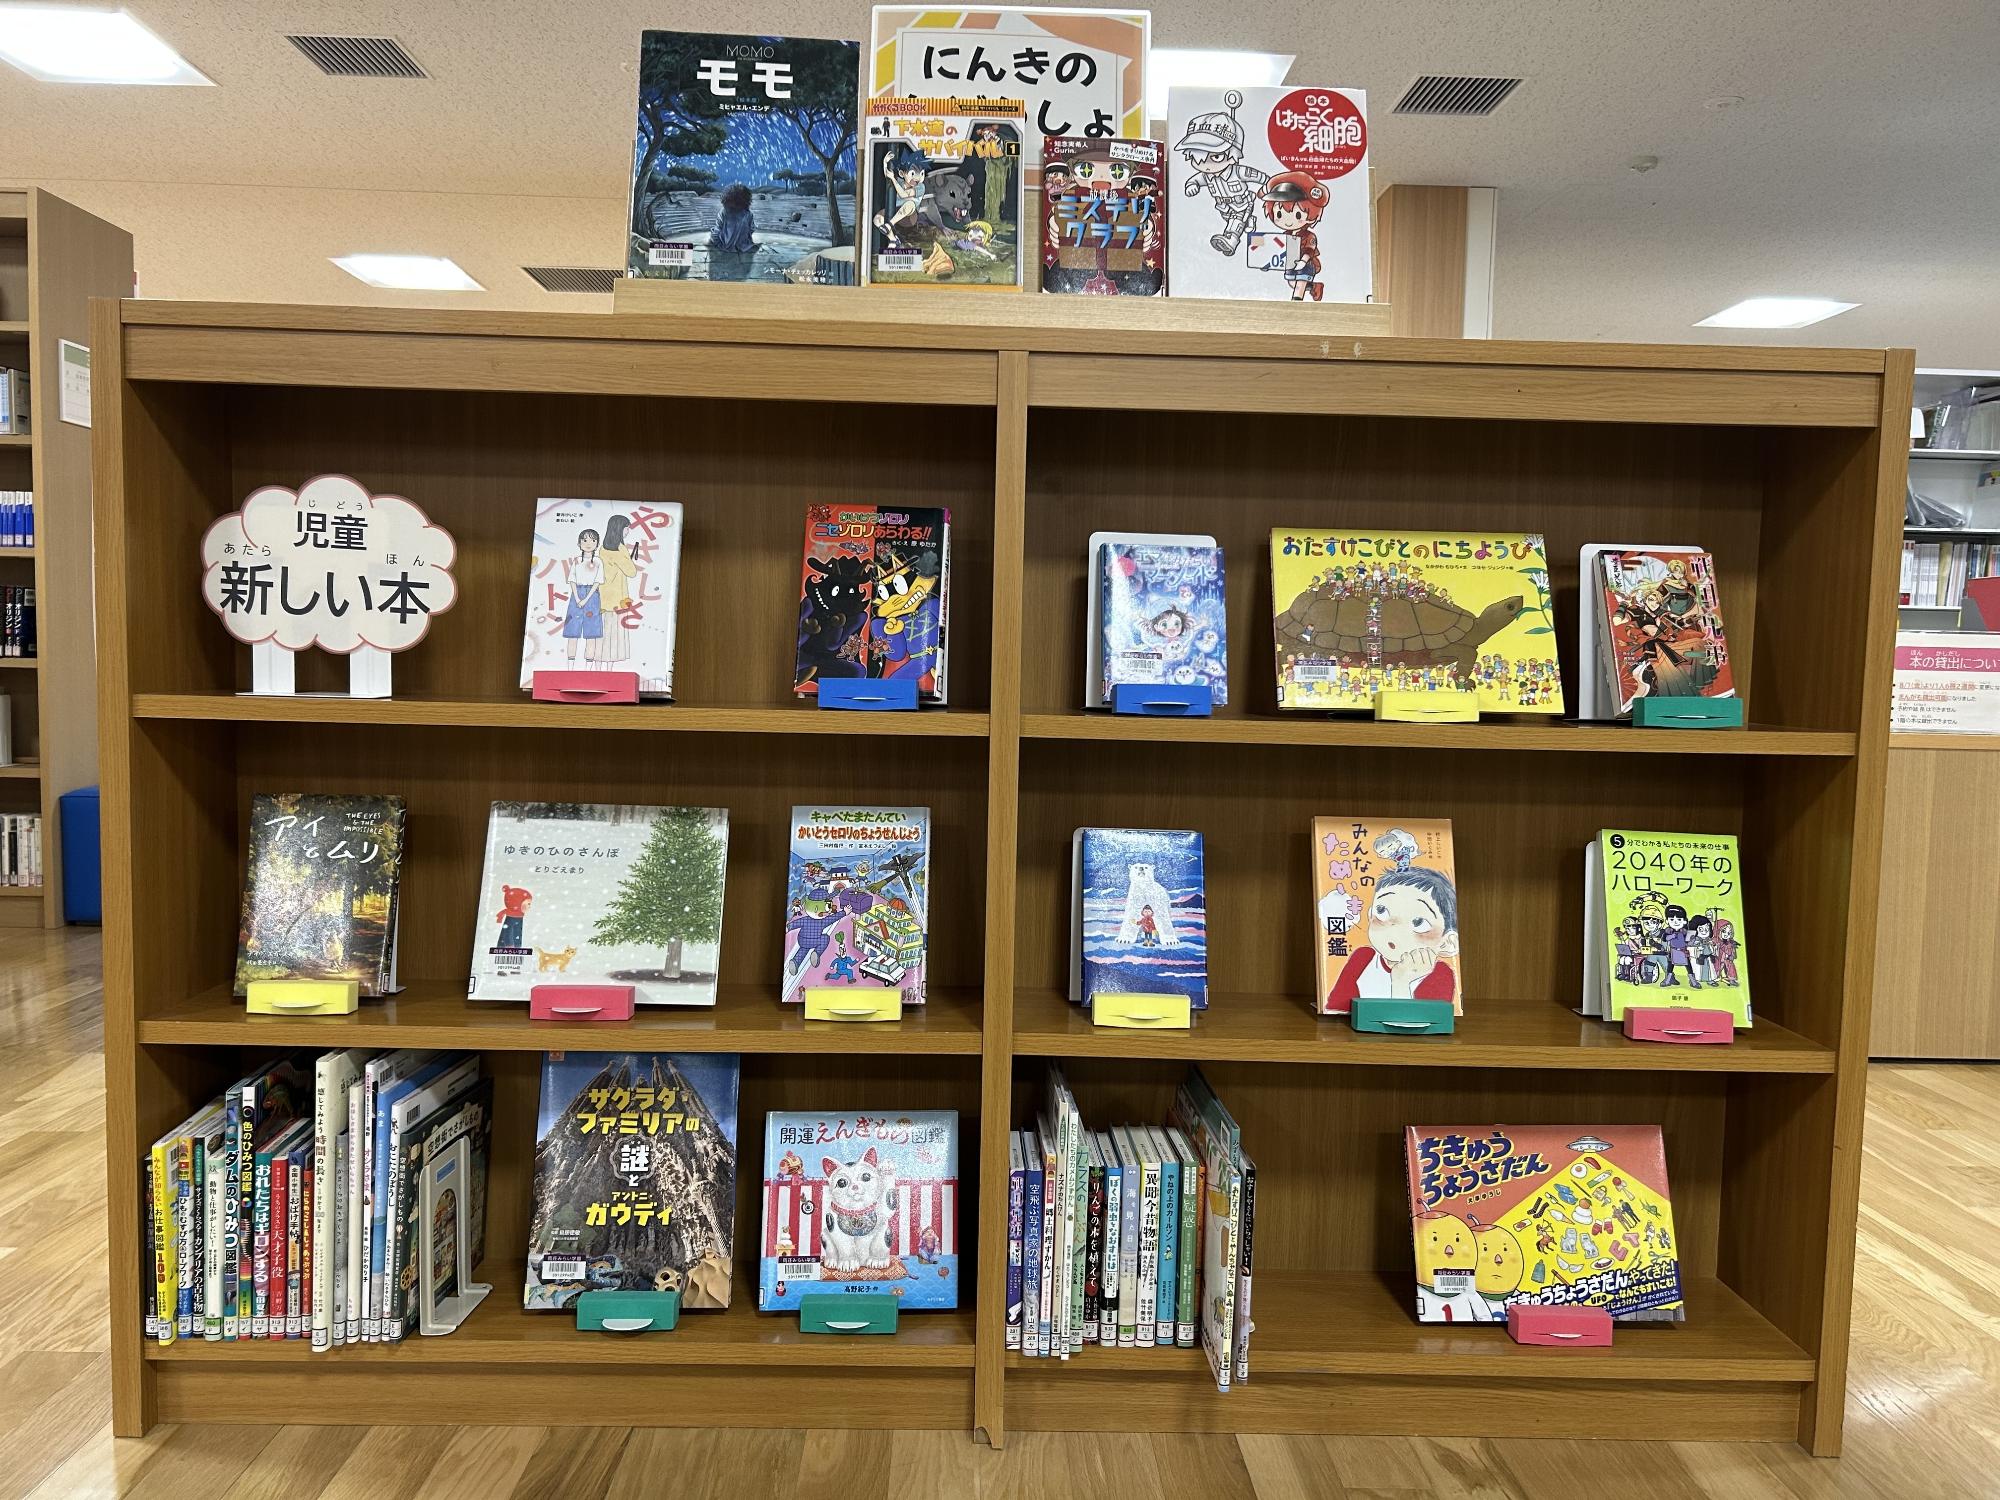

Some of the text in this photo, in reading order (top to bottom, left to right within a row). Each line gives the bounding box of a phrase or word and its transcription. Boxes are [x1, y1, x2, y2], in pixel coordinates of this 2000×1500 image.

[726, 44, 775, 58] MOMO
[696, 59, 794, 99] モモ
[923, 45, 1098, 88] にんきの
[1304, 95, 1330, 107] 絵本
[893, 119, 958, 137] 下水道の
[1275, 106, 1334, 131] はたらく
[918, 138, 1004, 158] サバイバル
[1298, 116, 1362, 154] 細胞
[1009, 145, 1016, 154] 1
[1053, 147, 1077, 155] Gurin.
[293, 510, 369, 550] 児童
[223, 542, 272, 556] あたら
[386, 553, 425, 567] ほん
[1282, 537, 1533, 560] おたすけこびとのにちようび
[219, 560, 430, 624] 新しい本
[264, 815, 326, 842] アイ
[343, 826, 383, 835] IMPOSSIBLE
[811, 811, 906, 823] キャベたまたんてい
[798, 826, 920, 841] かいとうセロリのちょうせんじょう
[503, 845, 619, 858] ゆきのひのさんぽ
[1351, 823, 1375, 887] みんなの
[1612, 850, 1732, 873] 2040年の
[534, 865, 585, 875] とりごえまり
[1611, 874, 1733, 896] ハローワーク
[1327, 916, 1348, 957] 図鑑
[576, 1111, 700, 1135] ファミリアの
[620, 1144, 650, 1173] 謎
[1418, 1132, 1513, 1174] ちきゅう
[628, 1174, 639, 1187] と
[1420, 1153, 1552, 1207] ちょうさだん
[224, 1150, 239, 1274] ダムのひみつ図鑑
[585, 1202, 673, 1227] ガウディ
[1125, 1187, 1137, 1243] 海を見た日
[1142, 1173, 1158, 1252] 異聞今昔物語
[1165, 1174, 1175, 1242] やねの上のカールソン
[155, 1207, 165, 1250] お仕事図鑑
[254, 1164, 271, 1282] おれたちはギロンする
[1087, 1182, 1100, 1288] りんごの木を植えて
[1106, 1178, 1119, 1270] ぼくの弱虫をなおすには
[1027, 1184, 1040, 1290] 空飛ぶ写真家の地球旅
[1042, 1207, 1054, 1271] 郷土料理ずかん
[193, 1237, 203, 1312] カンブリアの古生物
[1590, 1294, 1608, 1305] UFO
